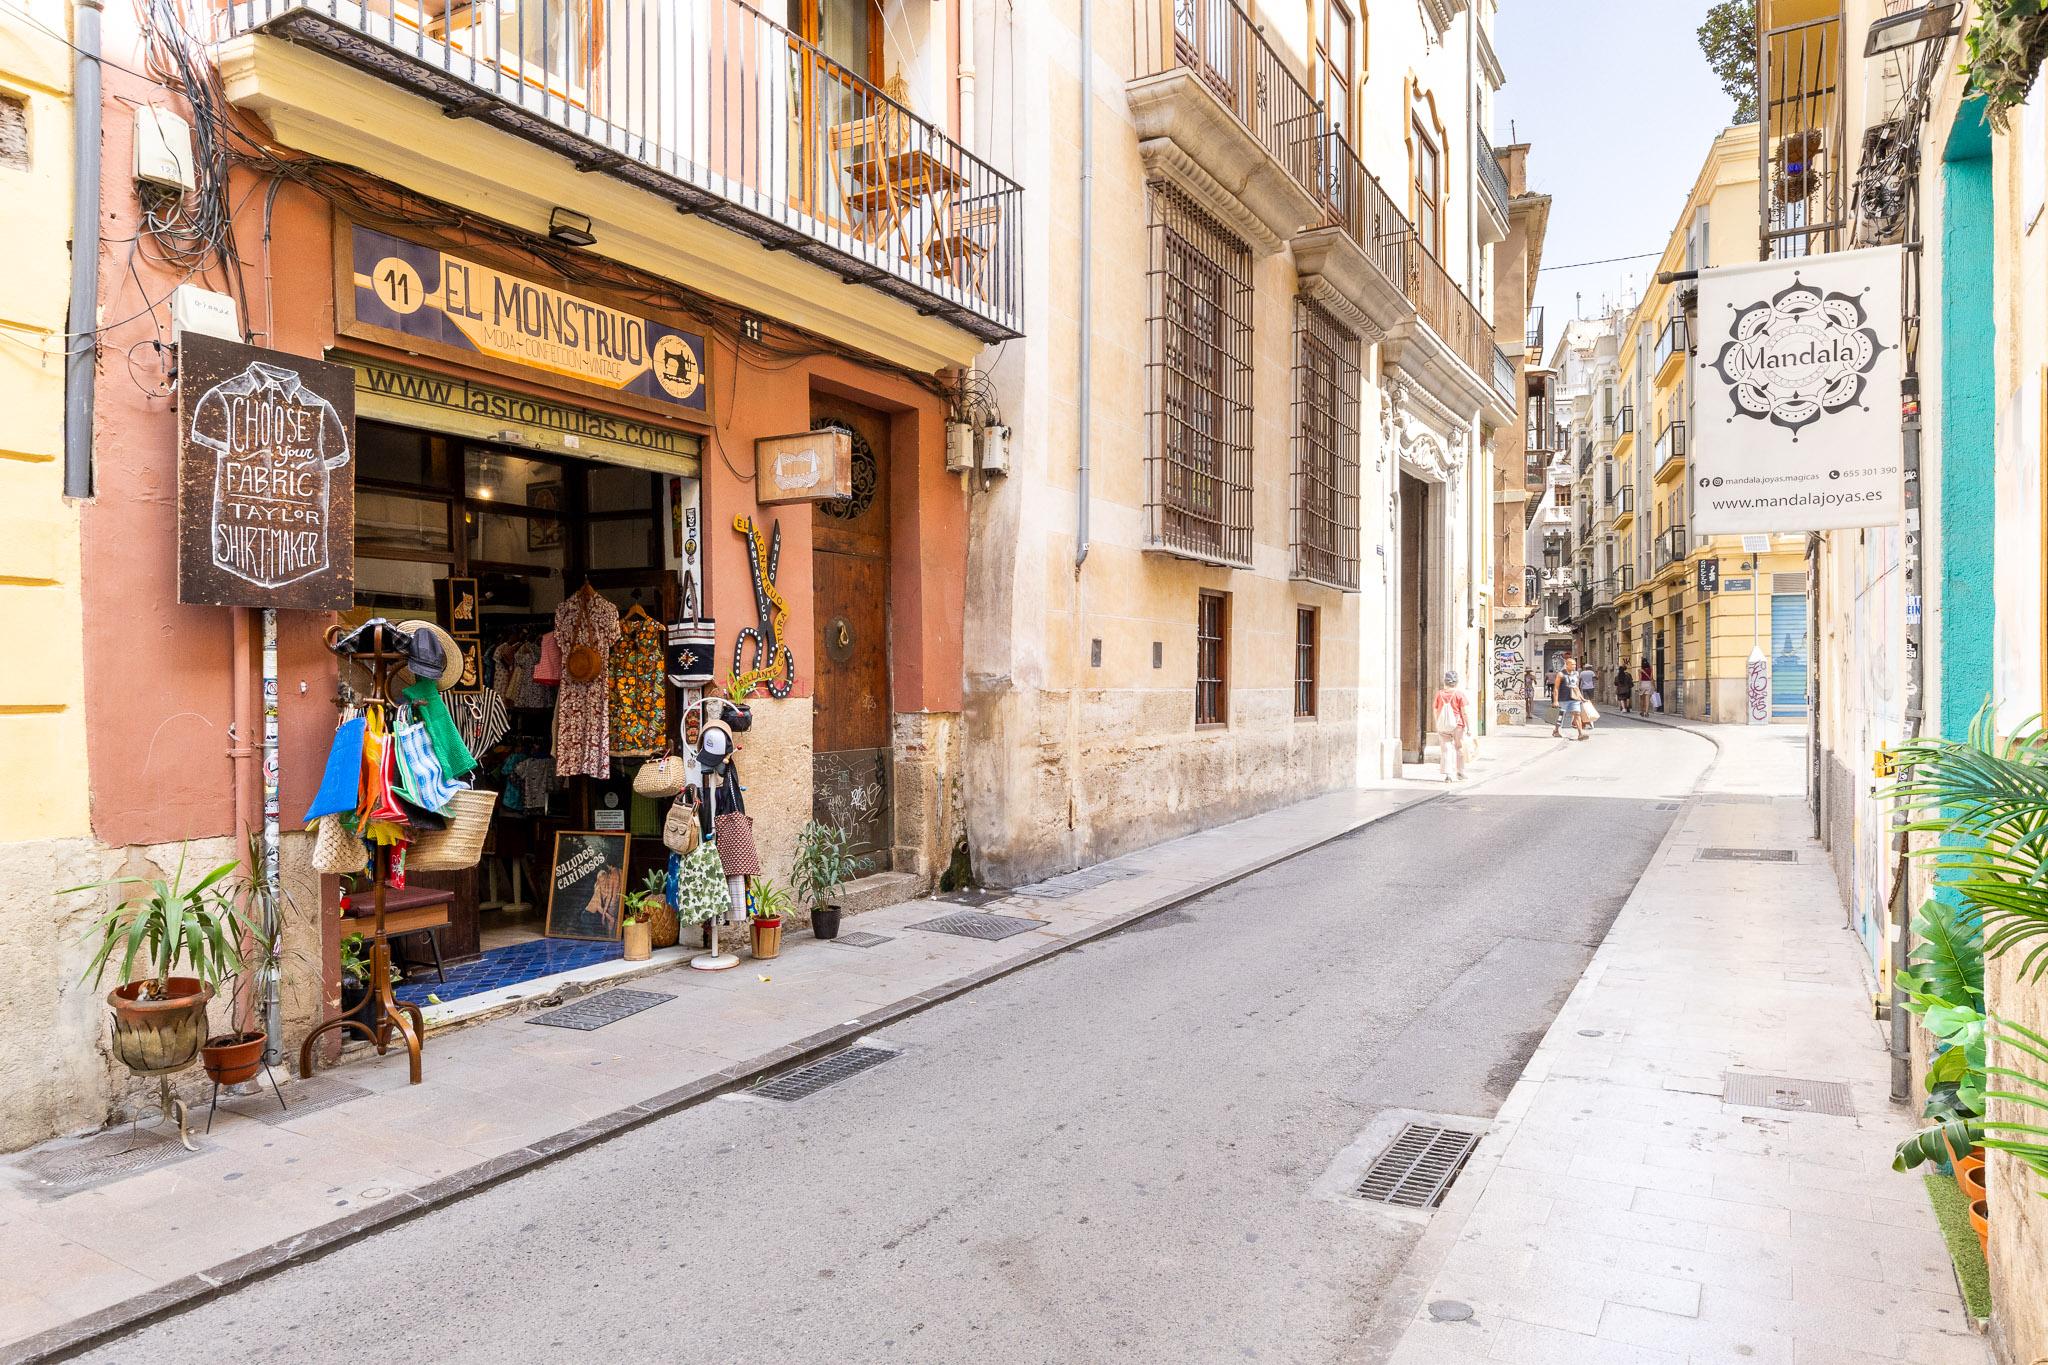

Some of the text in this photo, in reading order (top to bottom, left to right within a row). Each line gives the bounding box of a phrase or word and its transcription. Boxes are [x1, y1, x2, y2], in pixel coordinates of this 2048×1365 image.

[383, 268, 409, 306] 11
[444, 259, 643, 367] EL MONSTRUO
[745, 319, 758, 340] 11
[484, 326, 517, 351] MODA
[587, 356, 623, 381] VINTAGE
[1741, 338, 1854, 371] Mandala
[232, 396, 311, 453] CHOOSE
[366, 367, 675, 452] www.lasromulas.com
[226, 462, 314, 498] FABRIC
[1843, 470, 1860, 478] 655
[1862, 468, 1878, 477] 301
[1881, 466, 1897, 475] 390
[228, 503, 320, 525] TAYLOR
[1712, 490, 1883, 510] www.mandalajoyas.es
[737, 519, 783, 606] EL MONSTRUO
[770, 533, 781, 581] UNICO
[749, 532, 768, 622] FANTASTICO
[776, 612, 787, 667] COSTURA
[555, 845, 595, 877] SALUDOS
[557, 852, 605, 890] CARIÑOSOS
